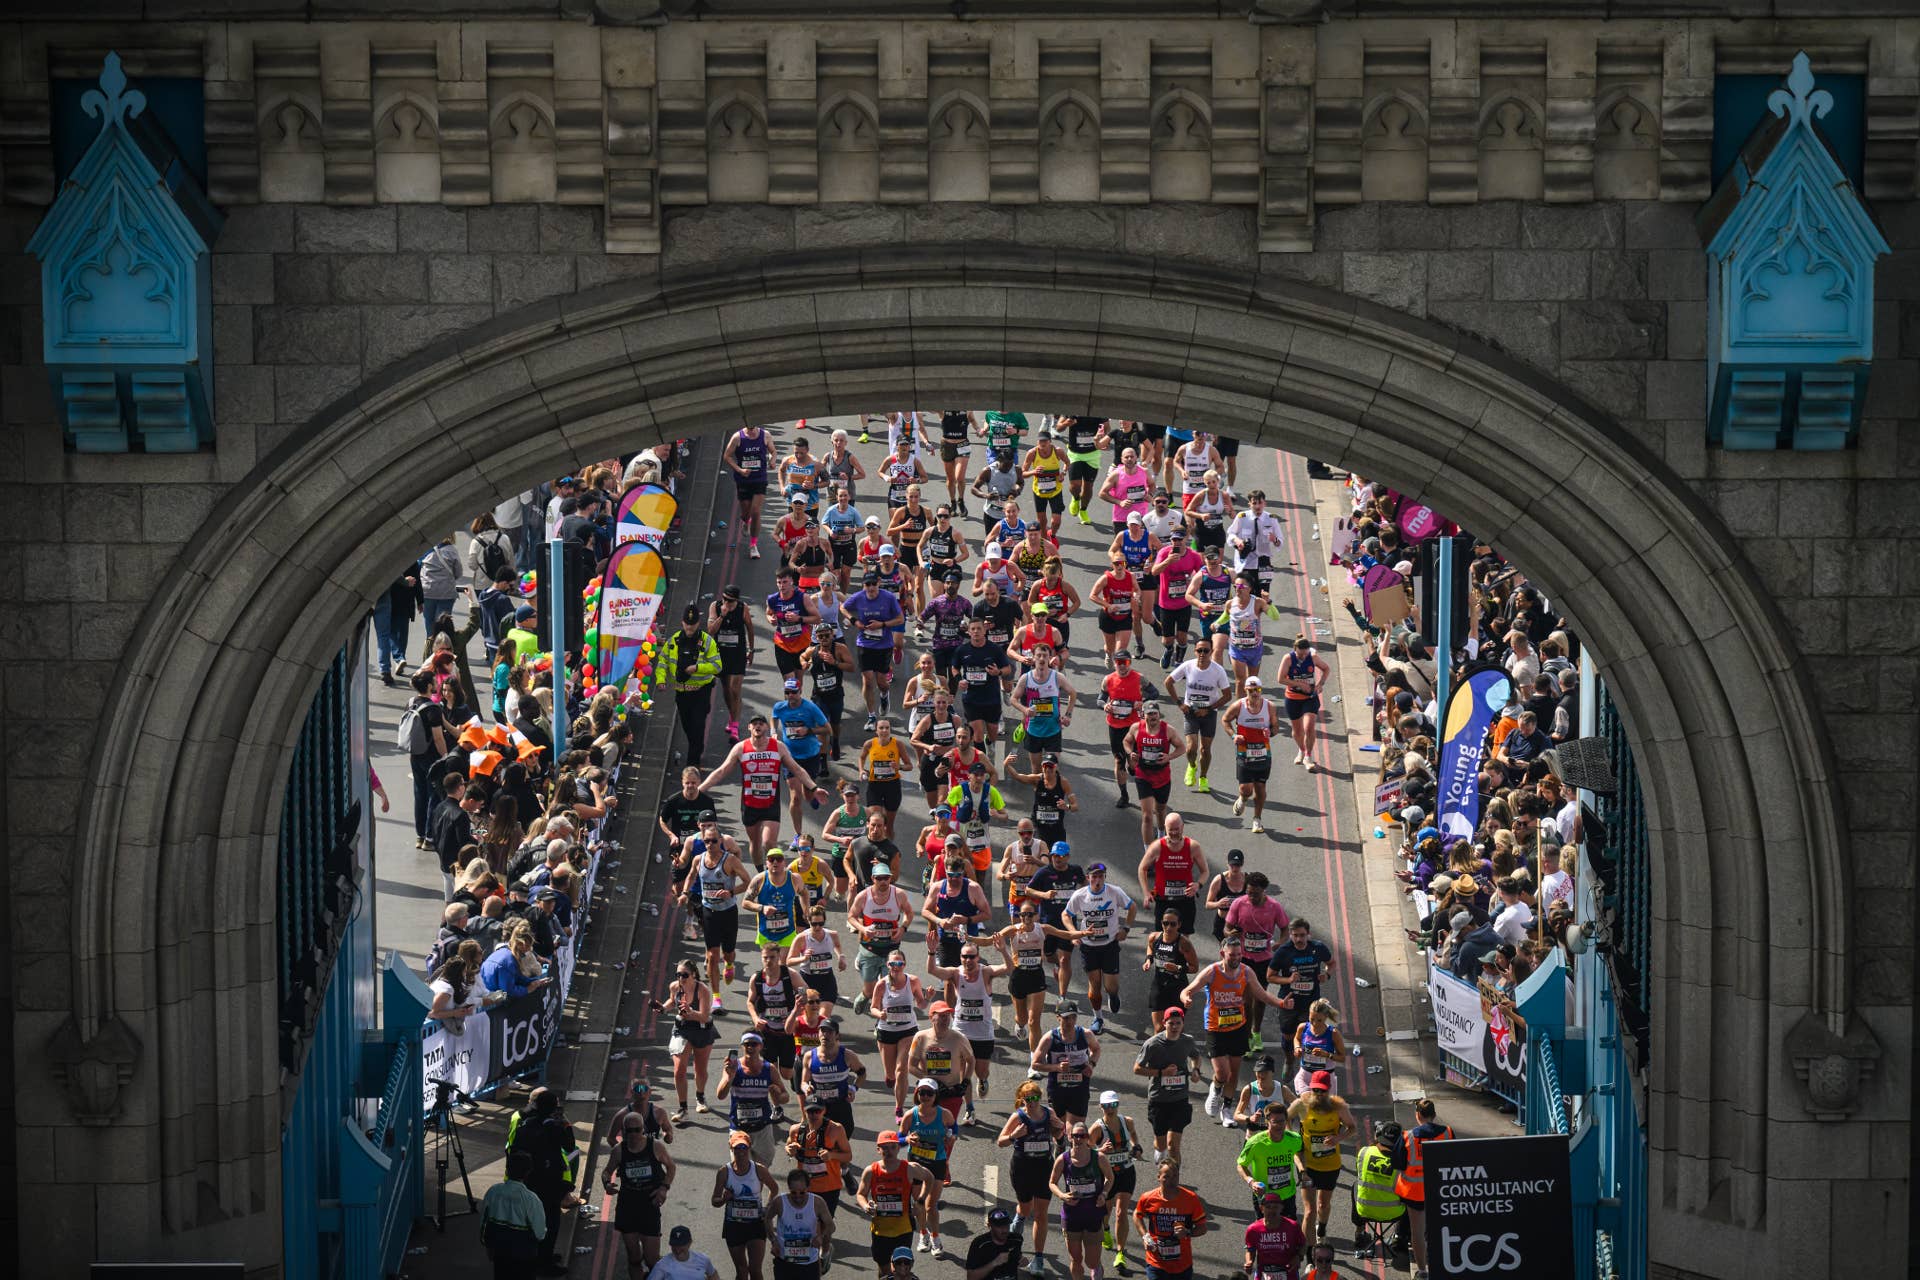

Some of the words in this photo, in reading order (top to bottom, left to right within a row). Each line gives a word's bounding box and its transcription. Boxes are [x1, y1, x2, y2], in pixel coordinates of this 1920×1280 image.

[620, 534, 664, 544] RAINBOW
[609, 597, 651, 609] RAINBOW
[1142, 737, 1162, 745] ELLIOT
[750, 752, 772, 760] KIRBY
[1445, 744, 1477, 804] Young
[1436, 1003, 1475, 1035] NSULTANCY
[502, 1013, 539, 1067] tcs
[424, 1046, 444, 1067] TATA
[819, 1065, 838, 1073] NOAH
[1267, 1153, 1292, 1165] CHRIS
[1438, 1166, 1488, 1181] TATA
[1439, 1179, 1555, 1198] CONSULTANCY
[1159, 1207, 1177, 1215] DAN
[1440, 1199, 1514, 1216] SERVICES
[1260, 1232, 1280, 1242] JAMES
[1441, 1226, 1522, 1274] tcs
